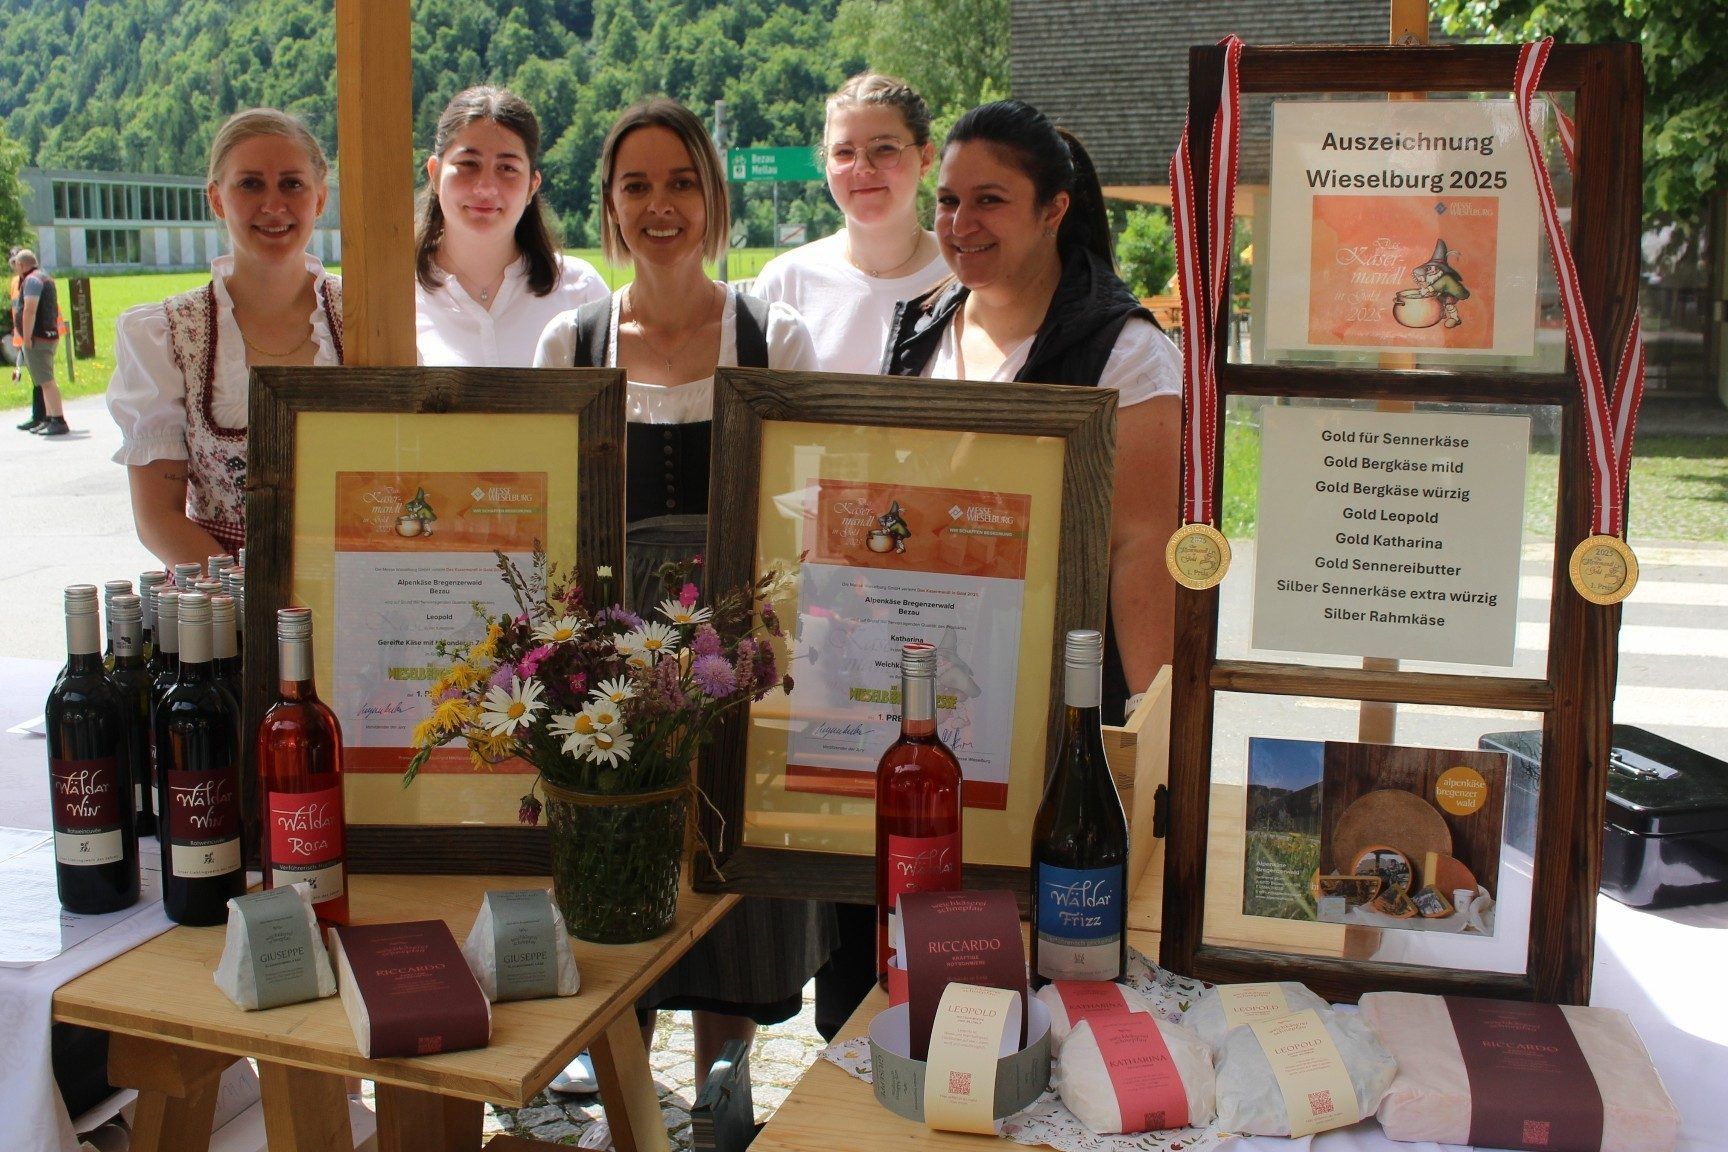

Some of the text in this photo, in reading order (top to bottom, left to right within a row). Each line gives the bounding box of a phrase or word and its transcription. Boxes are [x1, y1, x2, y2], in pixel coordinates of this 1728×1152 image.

[1321, 132, 1495, 155] Auszeichnung
[751, 154, 776, 164] Bezau
[1306, 169, 1507, 193] Wieselburg 2025
[1344, 307, 1386, 322] 2025
[1321, 430, 1469, 448] Gold für Sennerkäse
[1324, 456, 1464, 473] Gold Bergkäse mild
[1315, 481, 1471, 502] Gold Bergkäse würzig
[1342, 508, 1439, 525] Gold Leopold
[1335, 533, 1443, 549] Gold Katharina
[1596, 548, 1614, 556] 2025
[1314, 557, 1462, 576] Gold Sennereibutter
[397, 579, 483, 587] Alpenkäse Bregenzerwald
[1276, 580, 1497, 607] Silber Sennerkäse extra würzig
[865, 597, 955, 610] Alpenkäse Bregenzerwald
[426, 614, 453, 622] Leopold
[898, 608, 920, 616] Bezau
[1324, 608, 1445, 627] Silber Rahmkäse
[890, 634, 924, 644] Katharina
[886, 714, 902, 722] PRE
[1443, 778, 1486, 788] alpenkäse
[1436, 787, 1477, 798] bregenzer
[1059, 911, 1102, 927] Frizz
[928, 938, 1001, 954] RICCARDO
[260, 946, 305, 963] GIUSEPPE
[503, 950, 548, 964] GIUSEPPE
[375, 963, 446, 977] RICCARDO
[947, 1004, 997, 1018] LEOPOLD
[1069, 1002, 1123, 1010] KATHARINA
[1233, 1004, 1280, 1013] LEOPOLD
[1274, 1038, 1322, 1055] LEOPOLD
[1481, 1040, 1559, 1052] RICCARDO
[1109, 1054, 1167, 1068] KATHARINA
